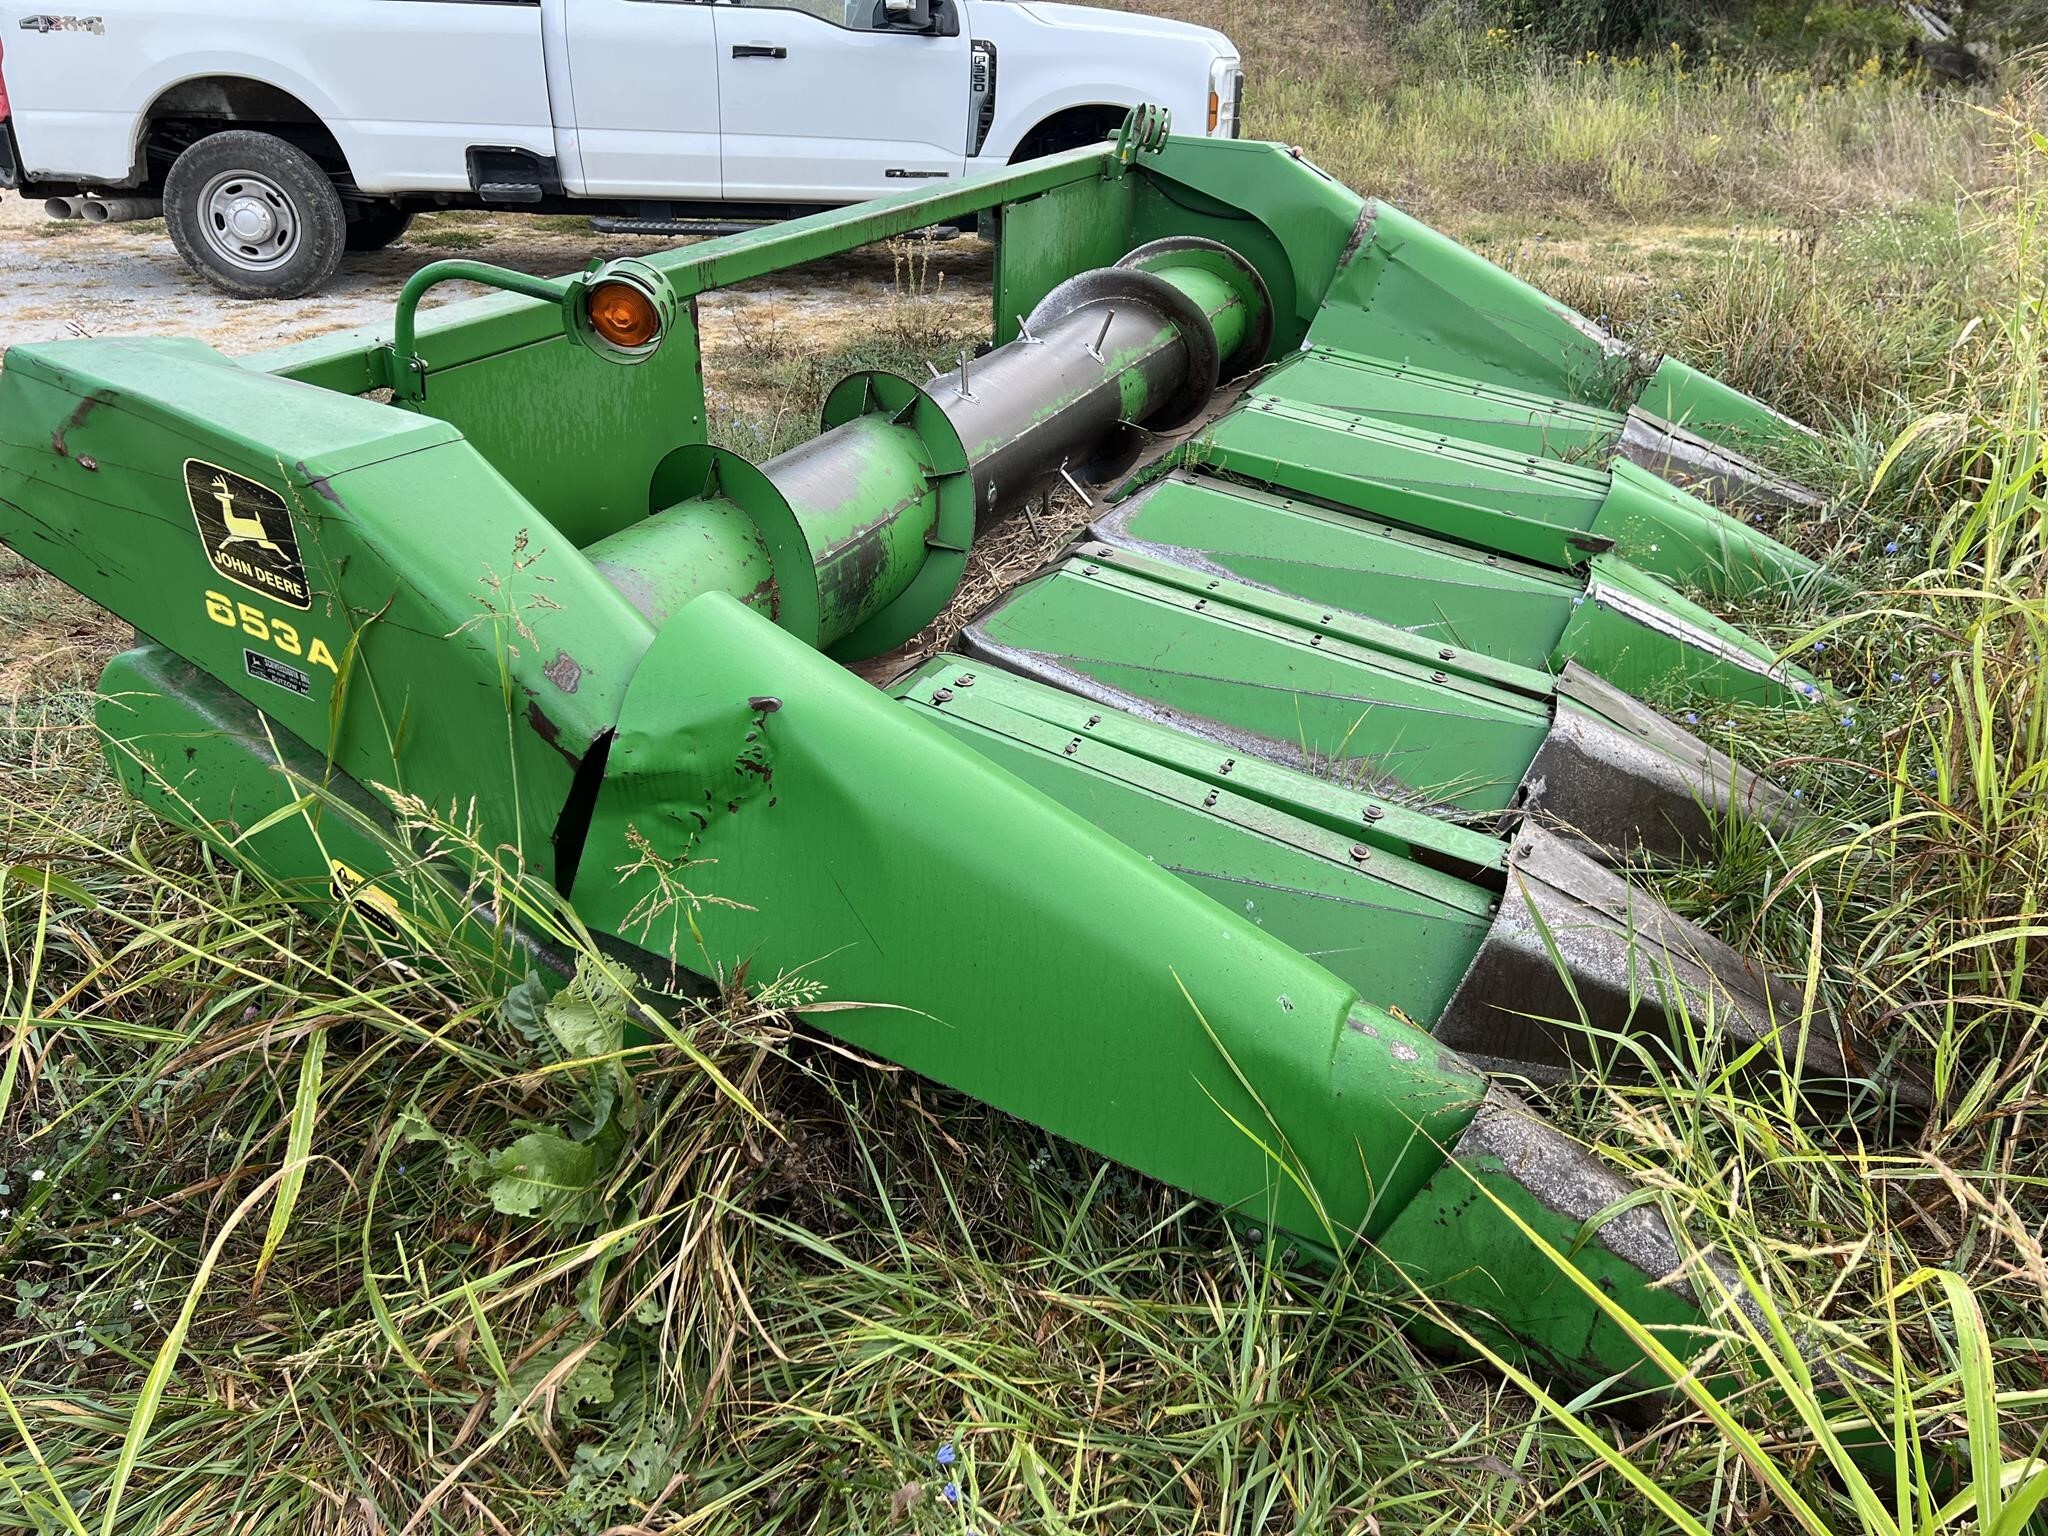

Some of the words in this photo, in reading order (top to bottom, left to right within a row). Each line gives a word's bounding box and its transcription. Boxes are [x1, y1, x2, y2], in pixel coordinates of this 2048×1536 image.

[214, 550, 253, 577] JOHN
[254, 566, 304, 599] DEERE
[205, 590, 339, 674] 653A
